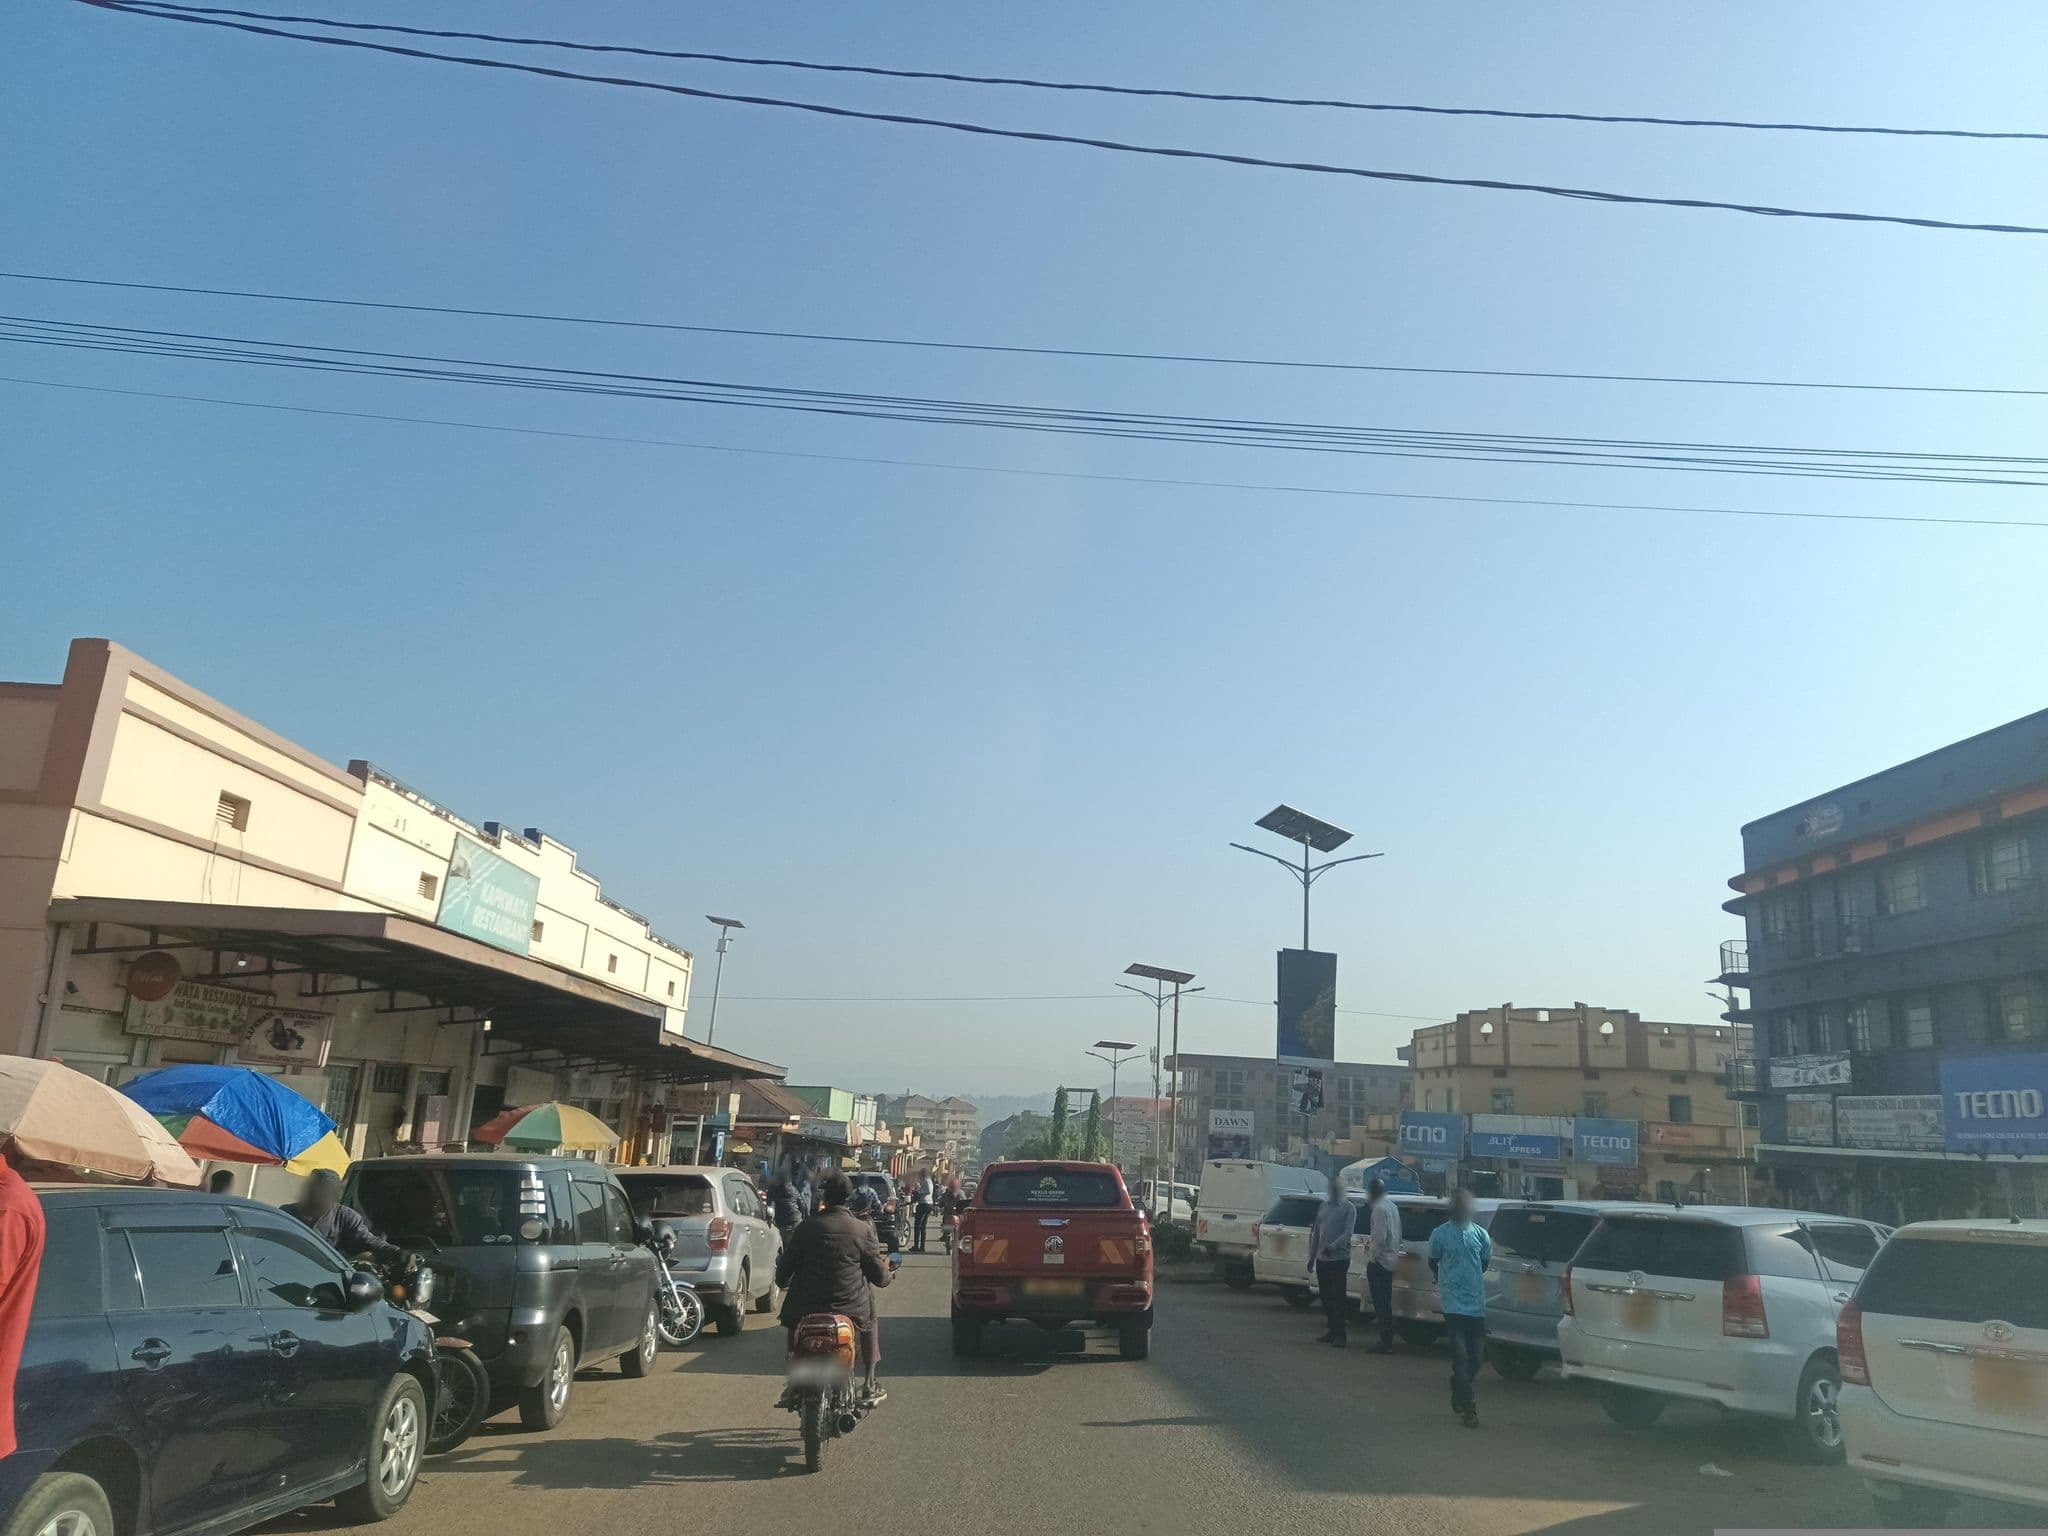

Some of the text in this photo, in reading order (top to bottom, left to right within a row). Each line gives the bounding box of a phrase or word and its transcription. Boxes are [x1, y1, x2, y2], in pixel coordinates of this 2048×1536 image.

[471, 904, 529, 945] RESTAURANT
[1953, 1088, 2043, 1119] TECNO
[1214, 1117, 1249, 1127] DAWN
[1509, 1146, 1541, 1154] XPRESS
[1580, 1134, 1631, 1150] TECNO
